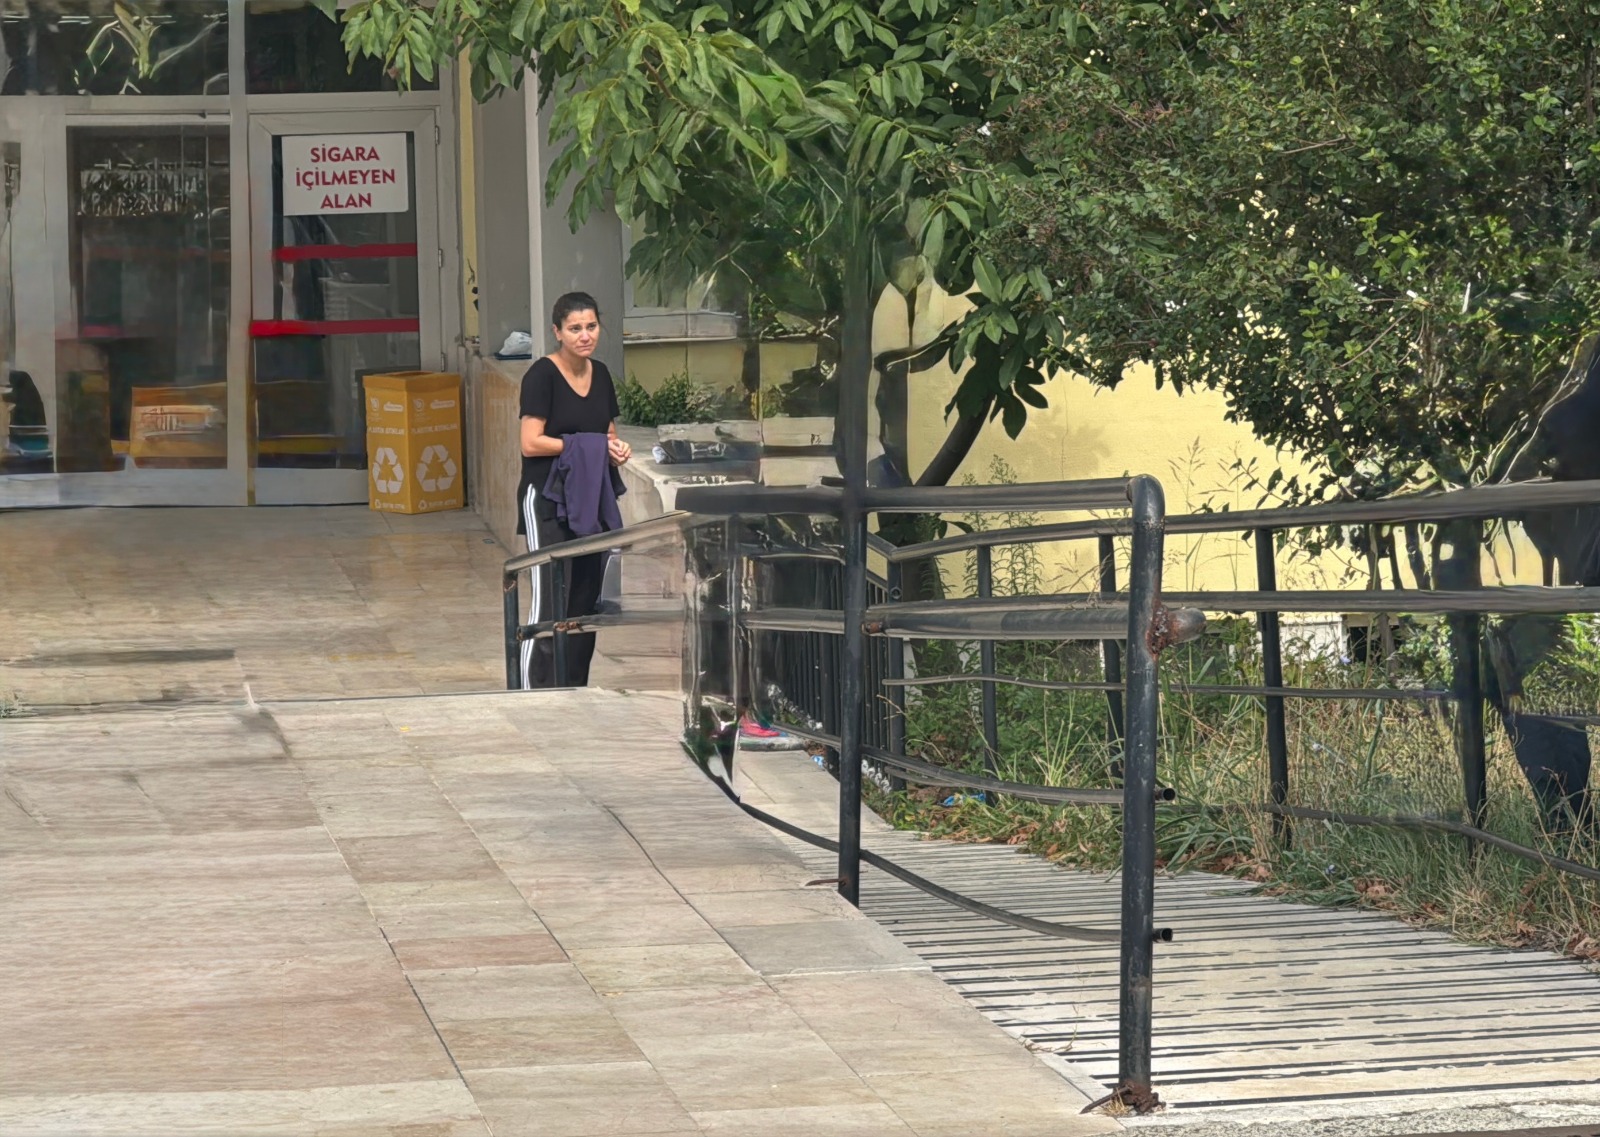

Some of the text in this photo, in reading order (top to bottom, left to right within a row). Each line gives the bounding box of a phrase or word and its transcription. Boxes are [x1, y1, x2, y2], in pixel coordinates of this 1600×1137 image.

[310, 143, 380, 163] SİGARA
[296, 167, 396, 191] İÇİLMEYEN
[320, 192, 372, 209] ALAN
